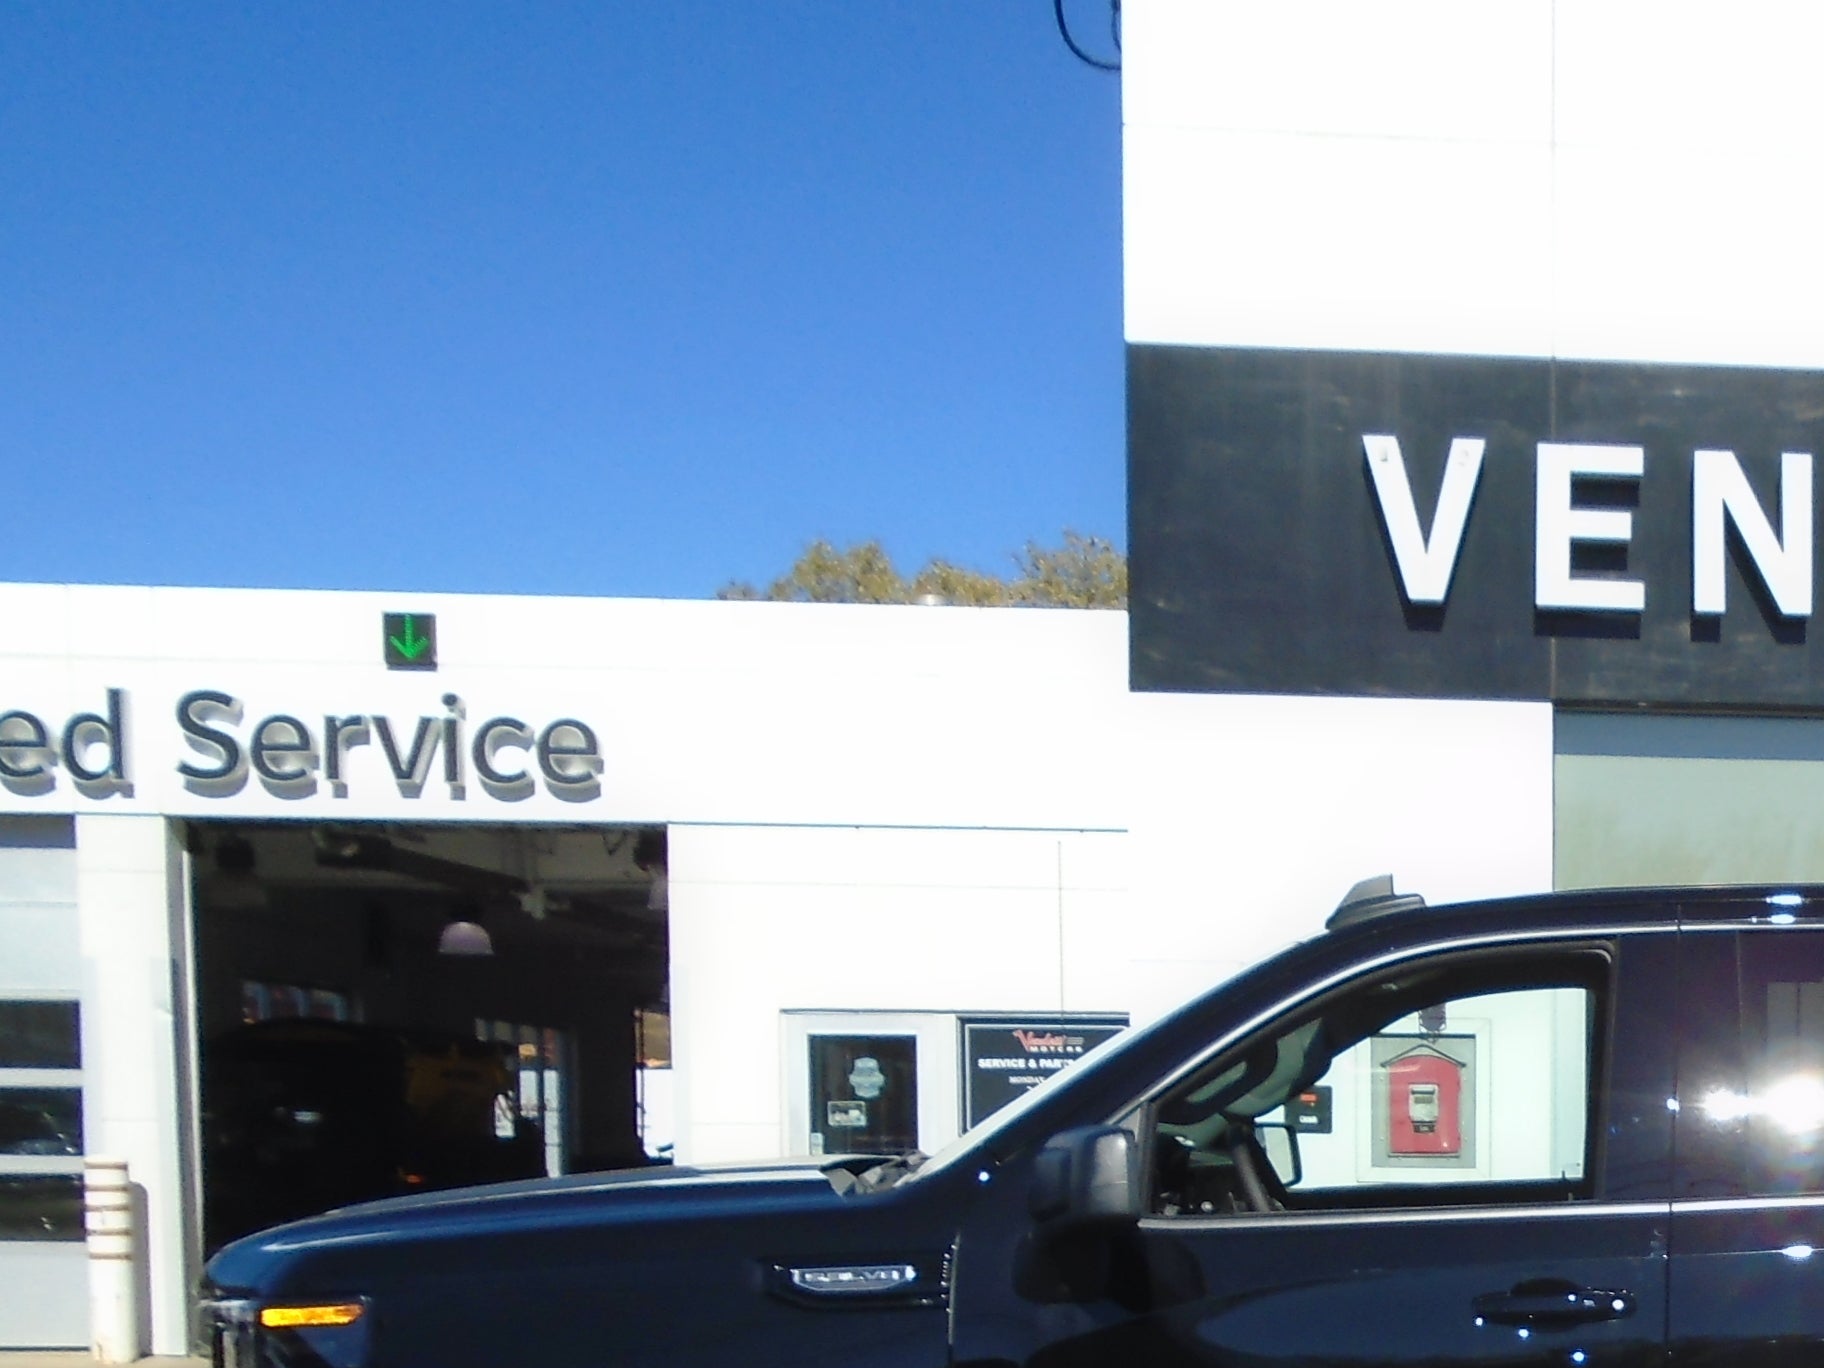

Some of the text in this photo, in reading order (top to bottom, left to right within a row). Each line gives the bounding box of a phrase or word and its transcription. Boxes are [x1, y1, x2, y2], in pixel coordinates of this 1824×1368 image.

[175, 688, 603, 790] Service
[978, 1058, 1026, 1069] SERVICE
[1028, 1058, 1037, 1069] &
